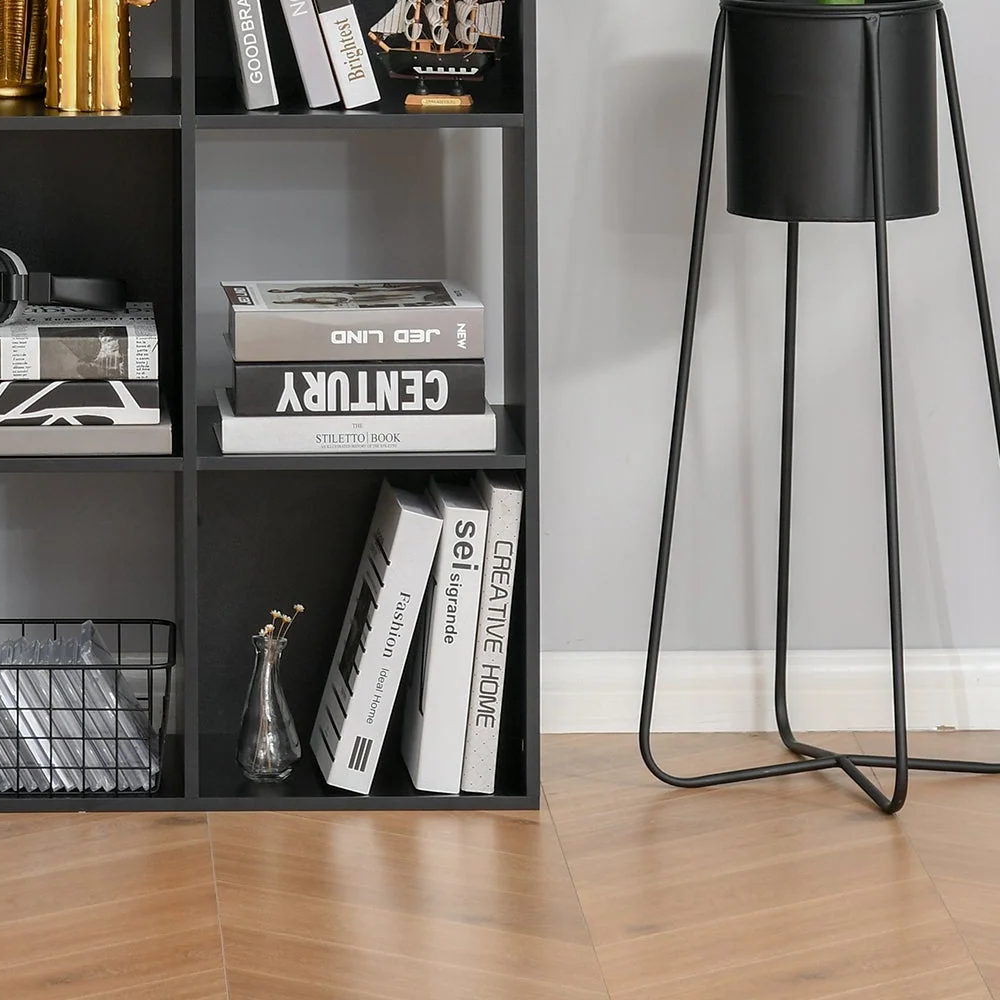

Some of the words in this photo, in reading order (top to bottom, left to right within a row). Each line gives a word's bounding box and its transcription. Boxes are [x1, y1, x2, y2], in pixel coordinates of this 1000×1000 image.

[242, 32, 264, 84] GOOD
[334, 18, 366, 82] Brightest
[331, 330, 382, 344] LIND
[393, 329, 441, 343] JED
[457, 323, 467, 349] NEW
[276, 369, 449, 412] CENTURY
[315, 433, 366, 444] STILETTO
[371, 432, 401, 443] BOOK
[443, 573, 462, 645] sigrande
[483, 540, 514, 654] CREATIVE
[382, 591, 411, 658] Fashion
[375, 667, 389, 694] Ideal
[475, 664, 501, 728] HOME
[366, 692, 382, 725] Home
